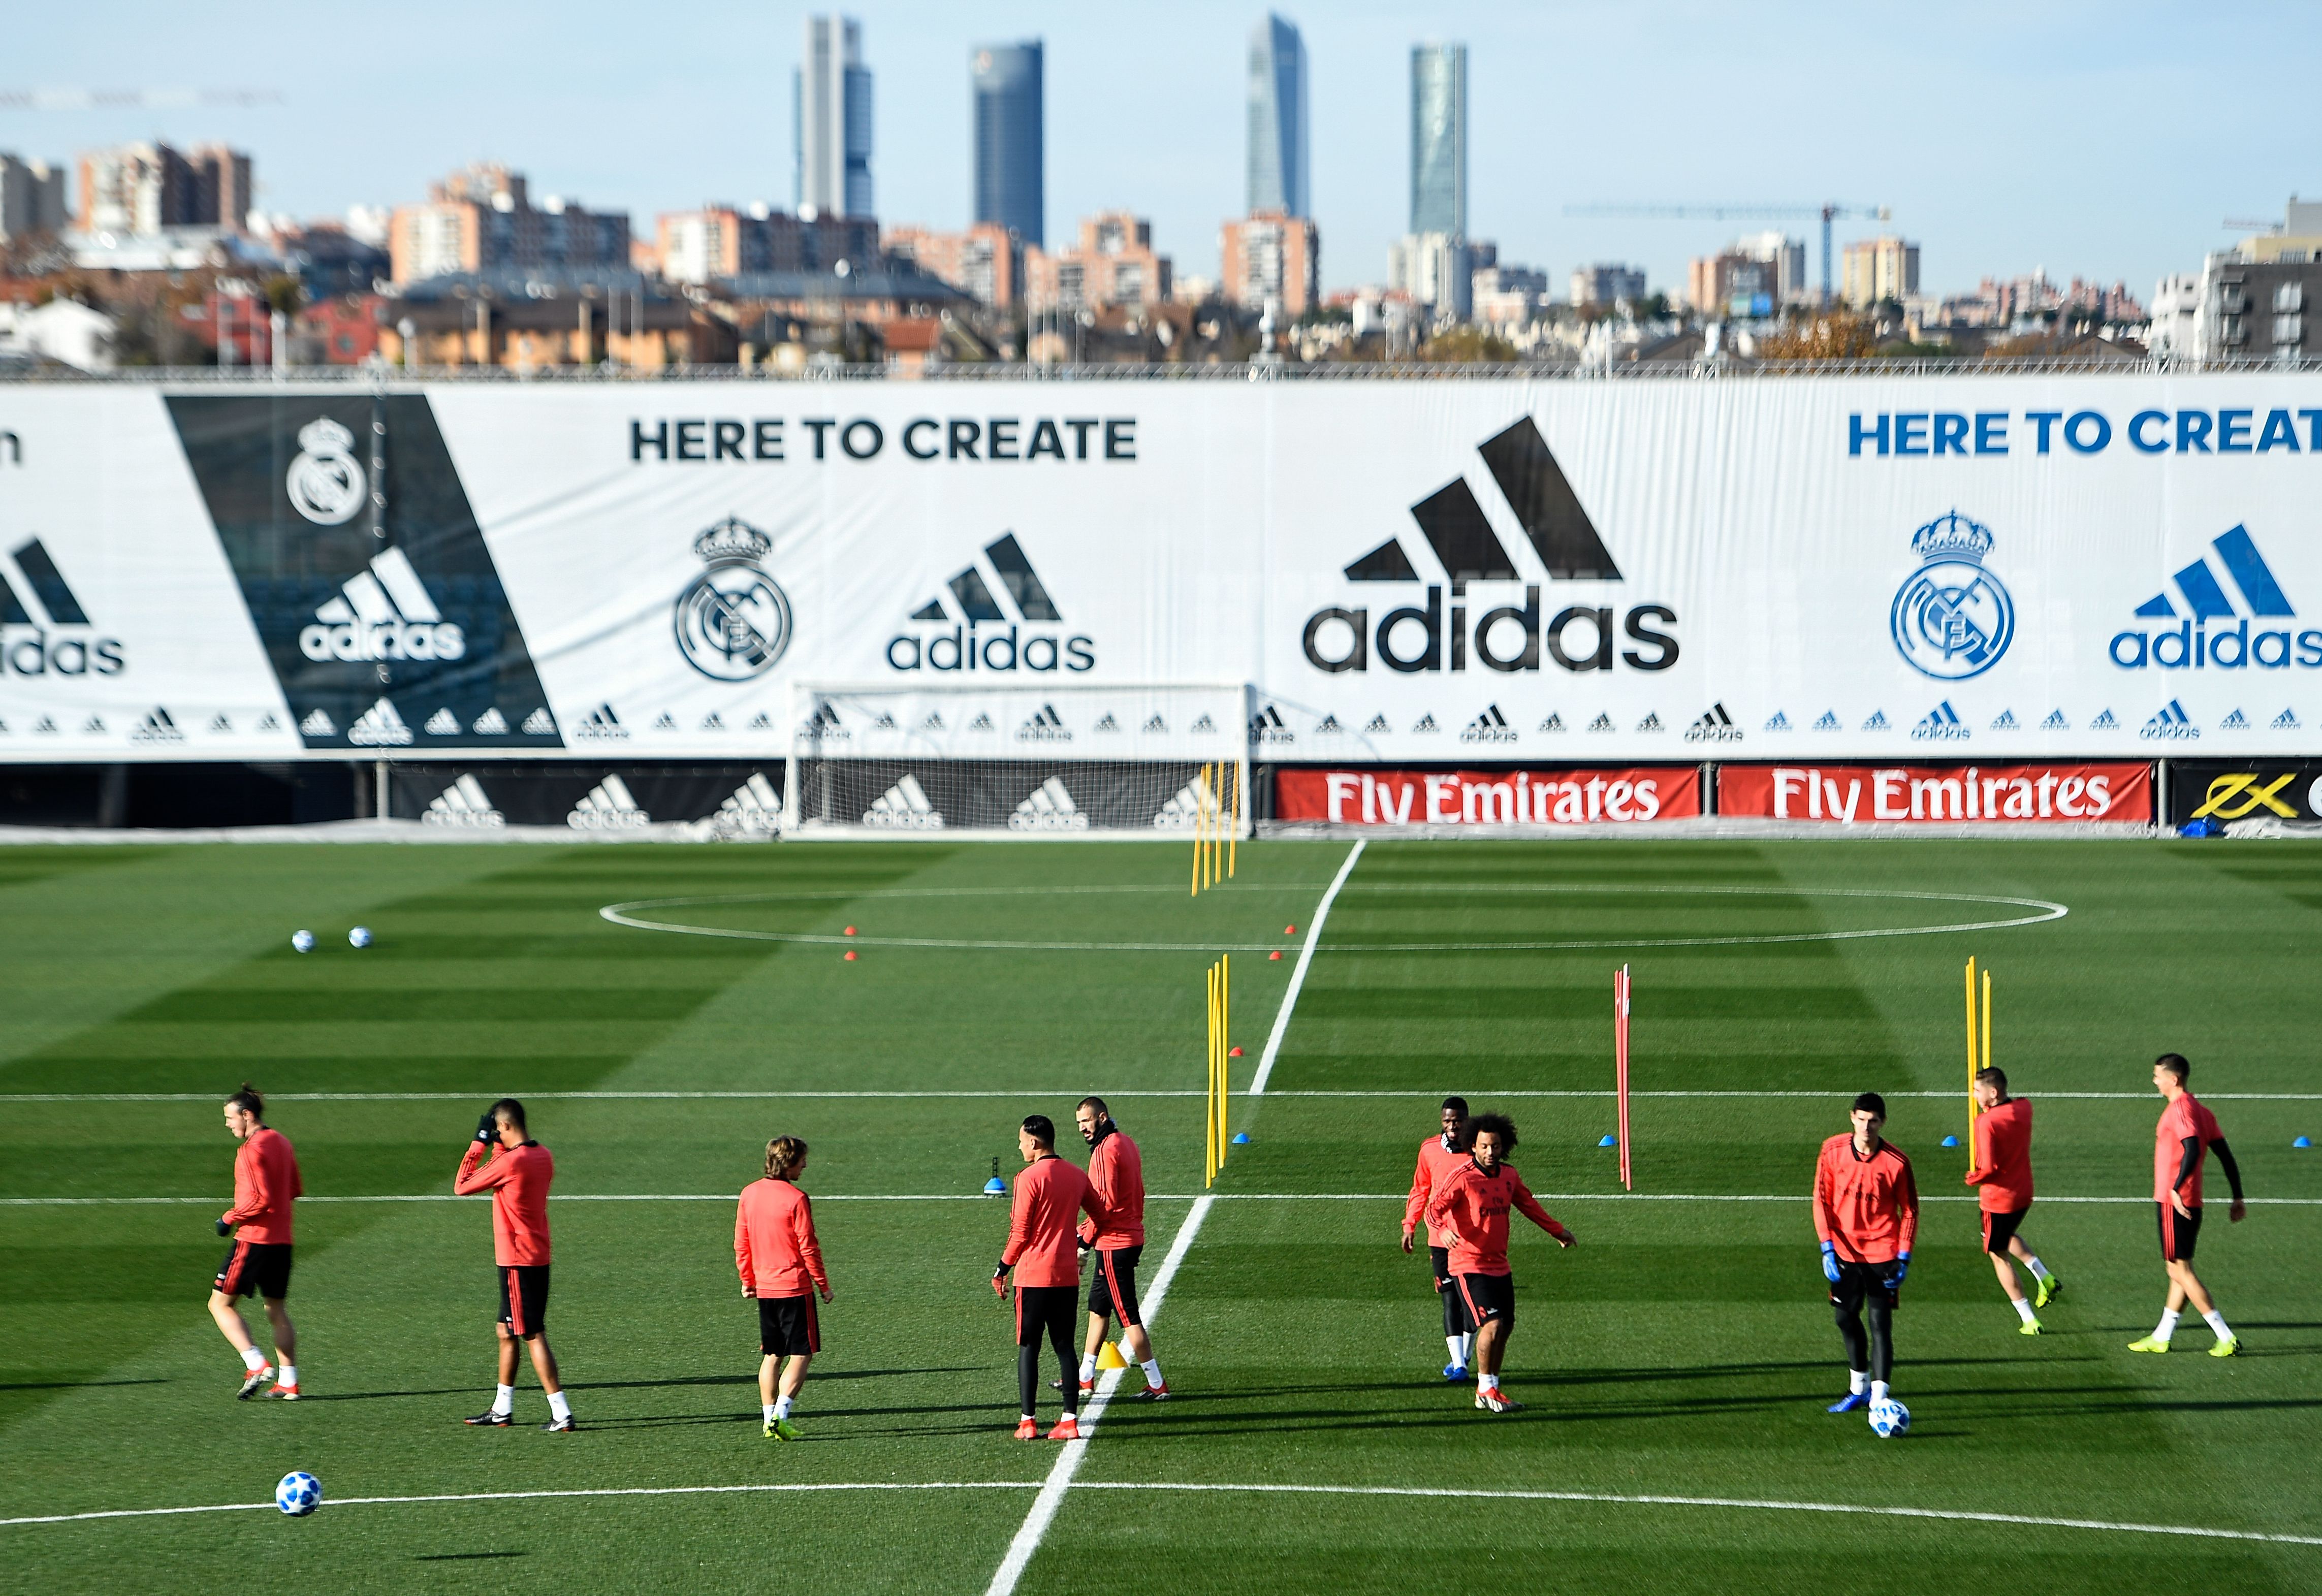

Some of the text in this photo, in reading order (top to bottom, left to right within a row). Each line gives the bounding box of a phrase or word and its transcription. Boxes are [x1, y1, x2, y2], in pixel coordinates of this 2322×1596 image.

[630, 420, 1138, 461] HERE TO CREATE
[1848, 413, 2010, 456] HERE
[2025, 411, 2112, 455] TO
[299, 616, 466, 662] adidas
[887, 625, 1096, 671] adidas
[1302, 585, 1680, 673] adidas
[2108, 620, 2322, 671] adidas
[1460, 725, 1519, 743] adidas
[1684, 724, 1743, 742] adidas
[1911, 723, 1971, 741] adidas
[2139, 722, 2201, 740] adidas
[1325, 771, 1661, 825] Fly Emirates
[1772, 767, 2112, 825] Fly Emirates
